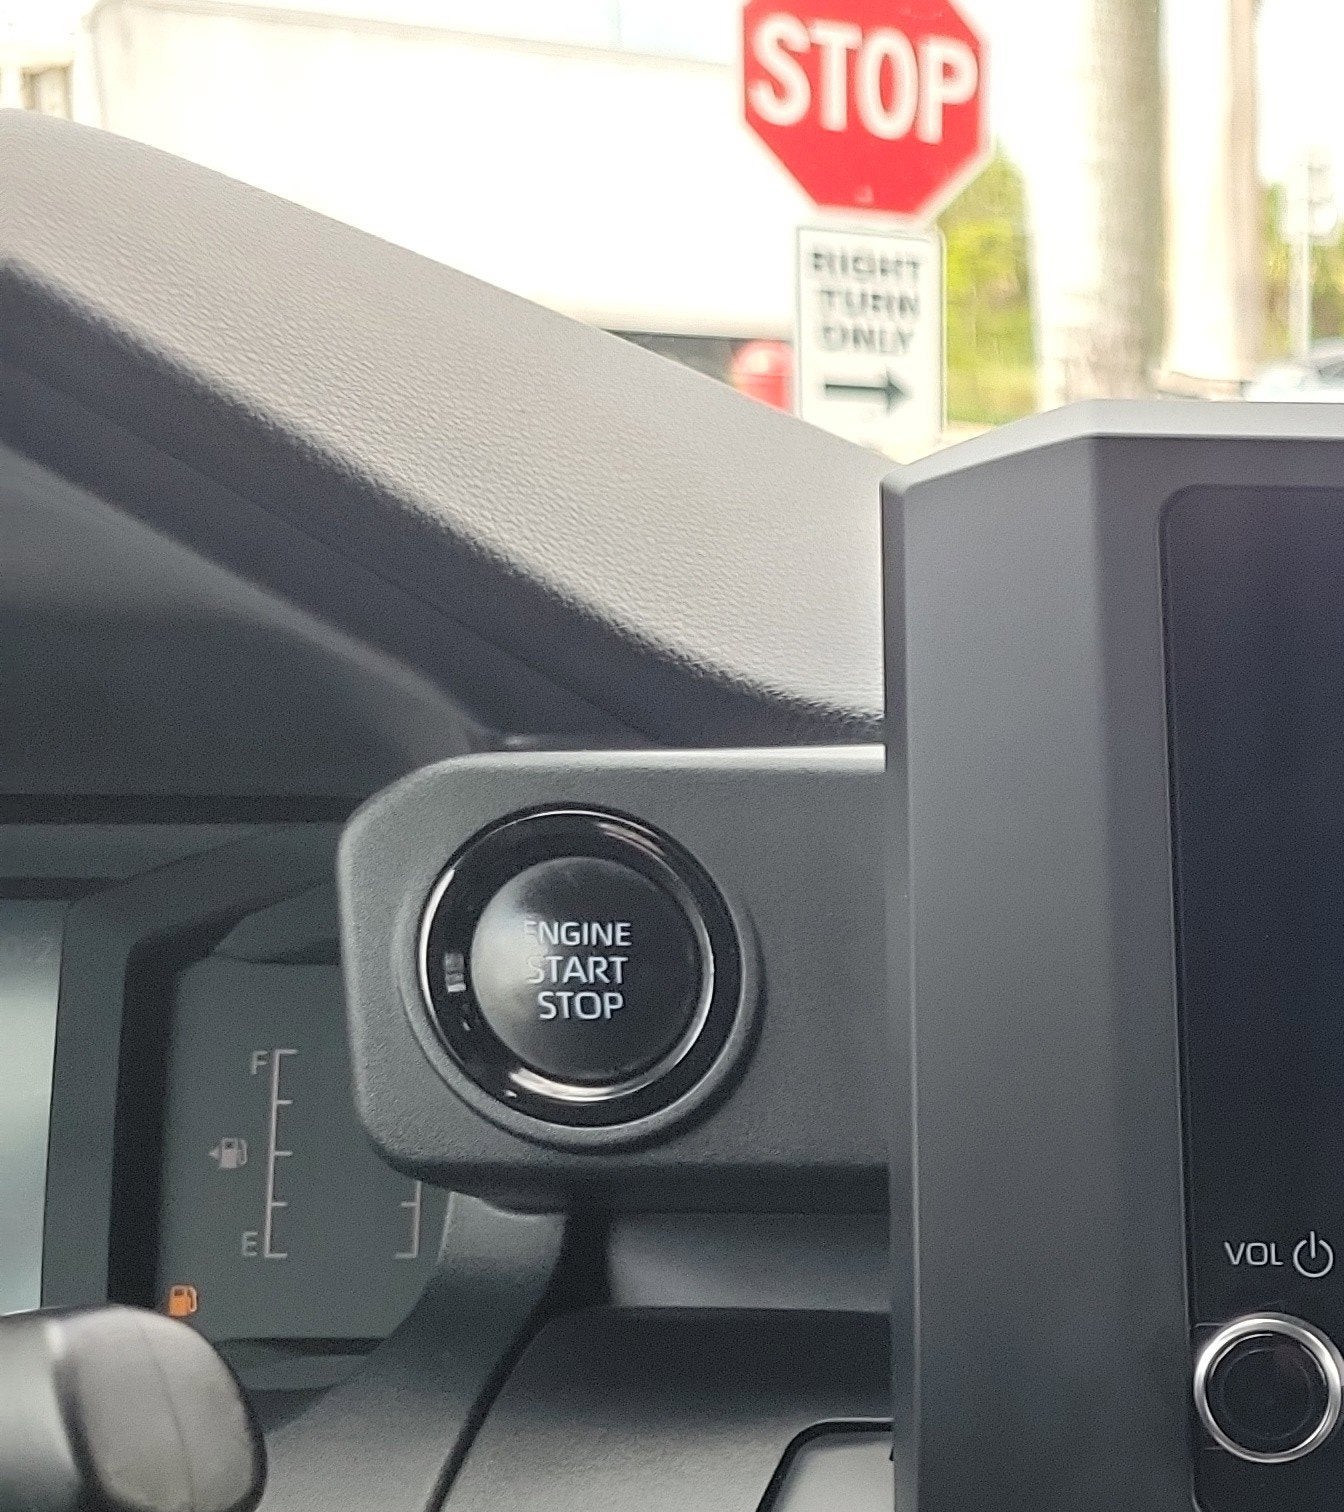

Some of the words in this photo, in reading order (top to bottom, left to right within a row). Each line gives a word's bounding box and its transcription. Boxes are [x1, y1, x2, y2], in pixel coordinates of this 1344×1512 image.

[748, 11, 980, 146] STOP
[812, 251, 921, 281] RIGHT
[818, 288, 921, 318] TURN
[821, 323, 915, 355] ONLY
[523, 920, 633, 947] ENGINE
[526, 954, 630, 985] START
[537, 990, 625, 1021] STOP
[251, 1050, 269, 1076] F
[241, 1231, 259, 1257] E
[1223, 1240, 1284, 1267] VOL
